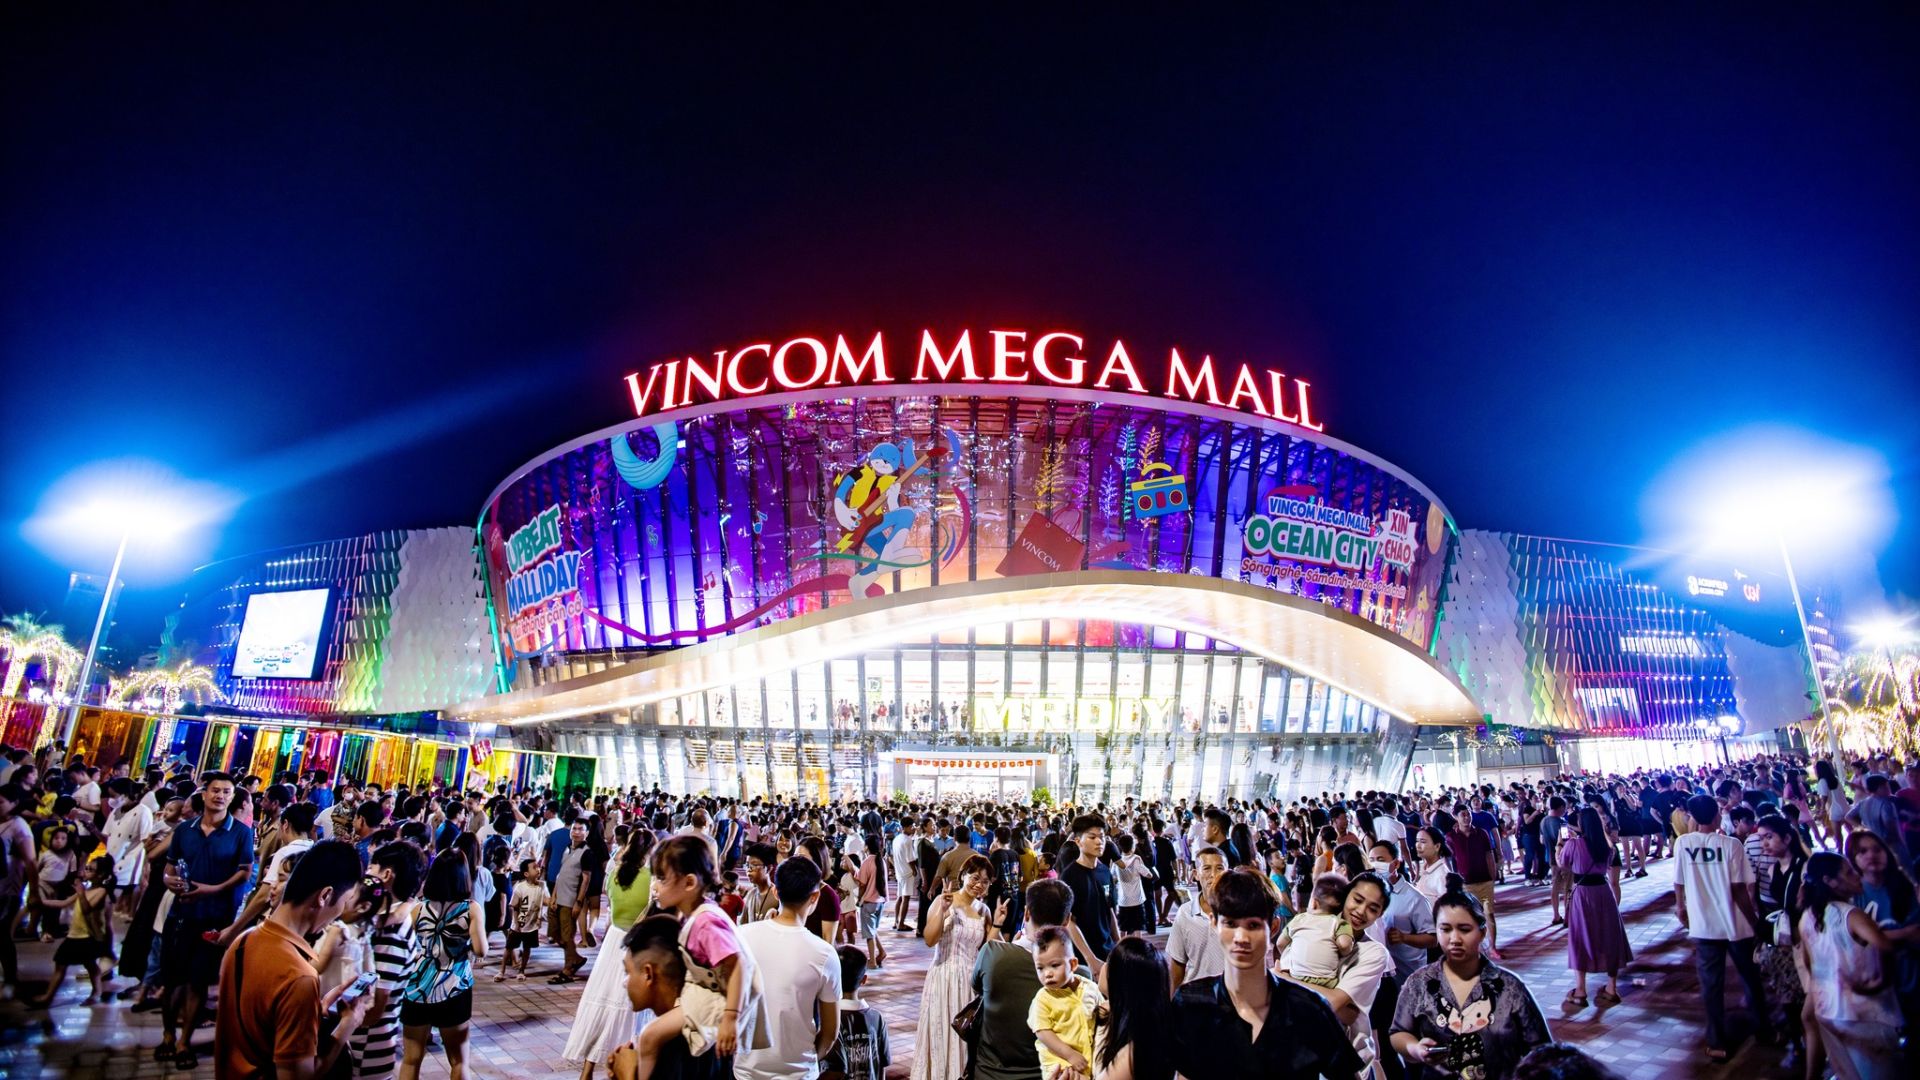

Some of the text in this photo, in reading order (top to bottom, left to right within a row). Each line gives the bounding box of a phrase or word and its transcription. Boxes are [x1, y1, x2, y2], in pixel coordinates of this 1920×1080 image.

[624, 328, 1323, 432] VINCOM MEGA MALL
[1269, 496, 1370, 533] VINCOM MEGA MALL
[1391, 511, 1409, 534] XIN
[506, 505, 561, 573] UPBEAT
[1021, 538, 1062, 572] VINCOM
[1247, 518, 1378, 566] OCEAN CITY
[507, 553, 579, 618] MALLIDAY
